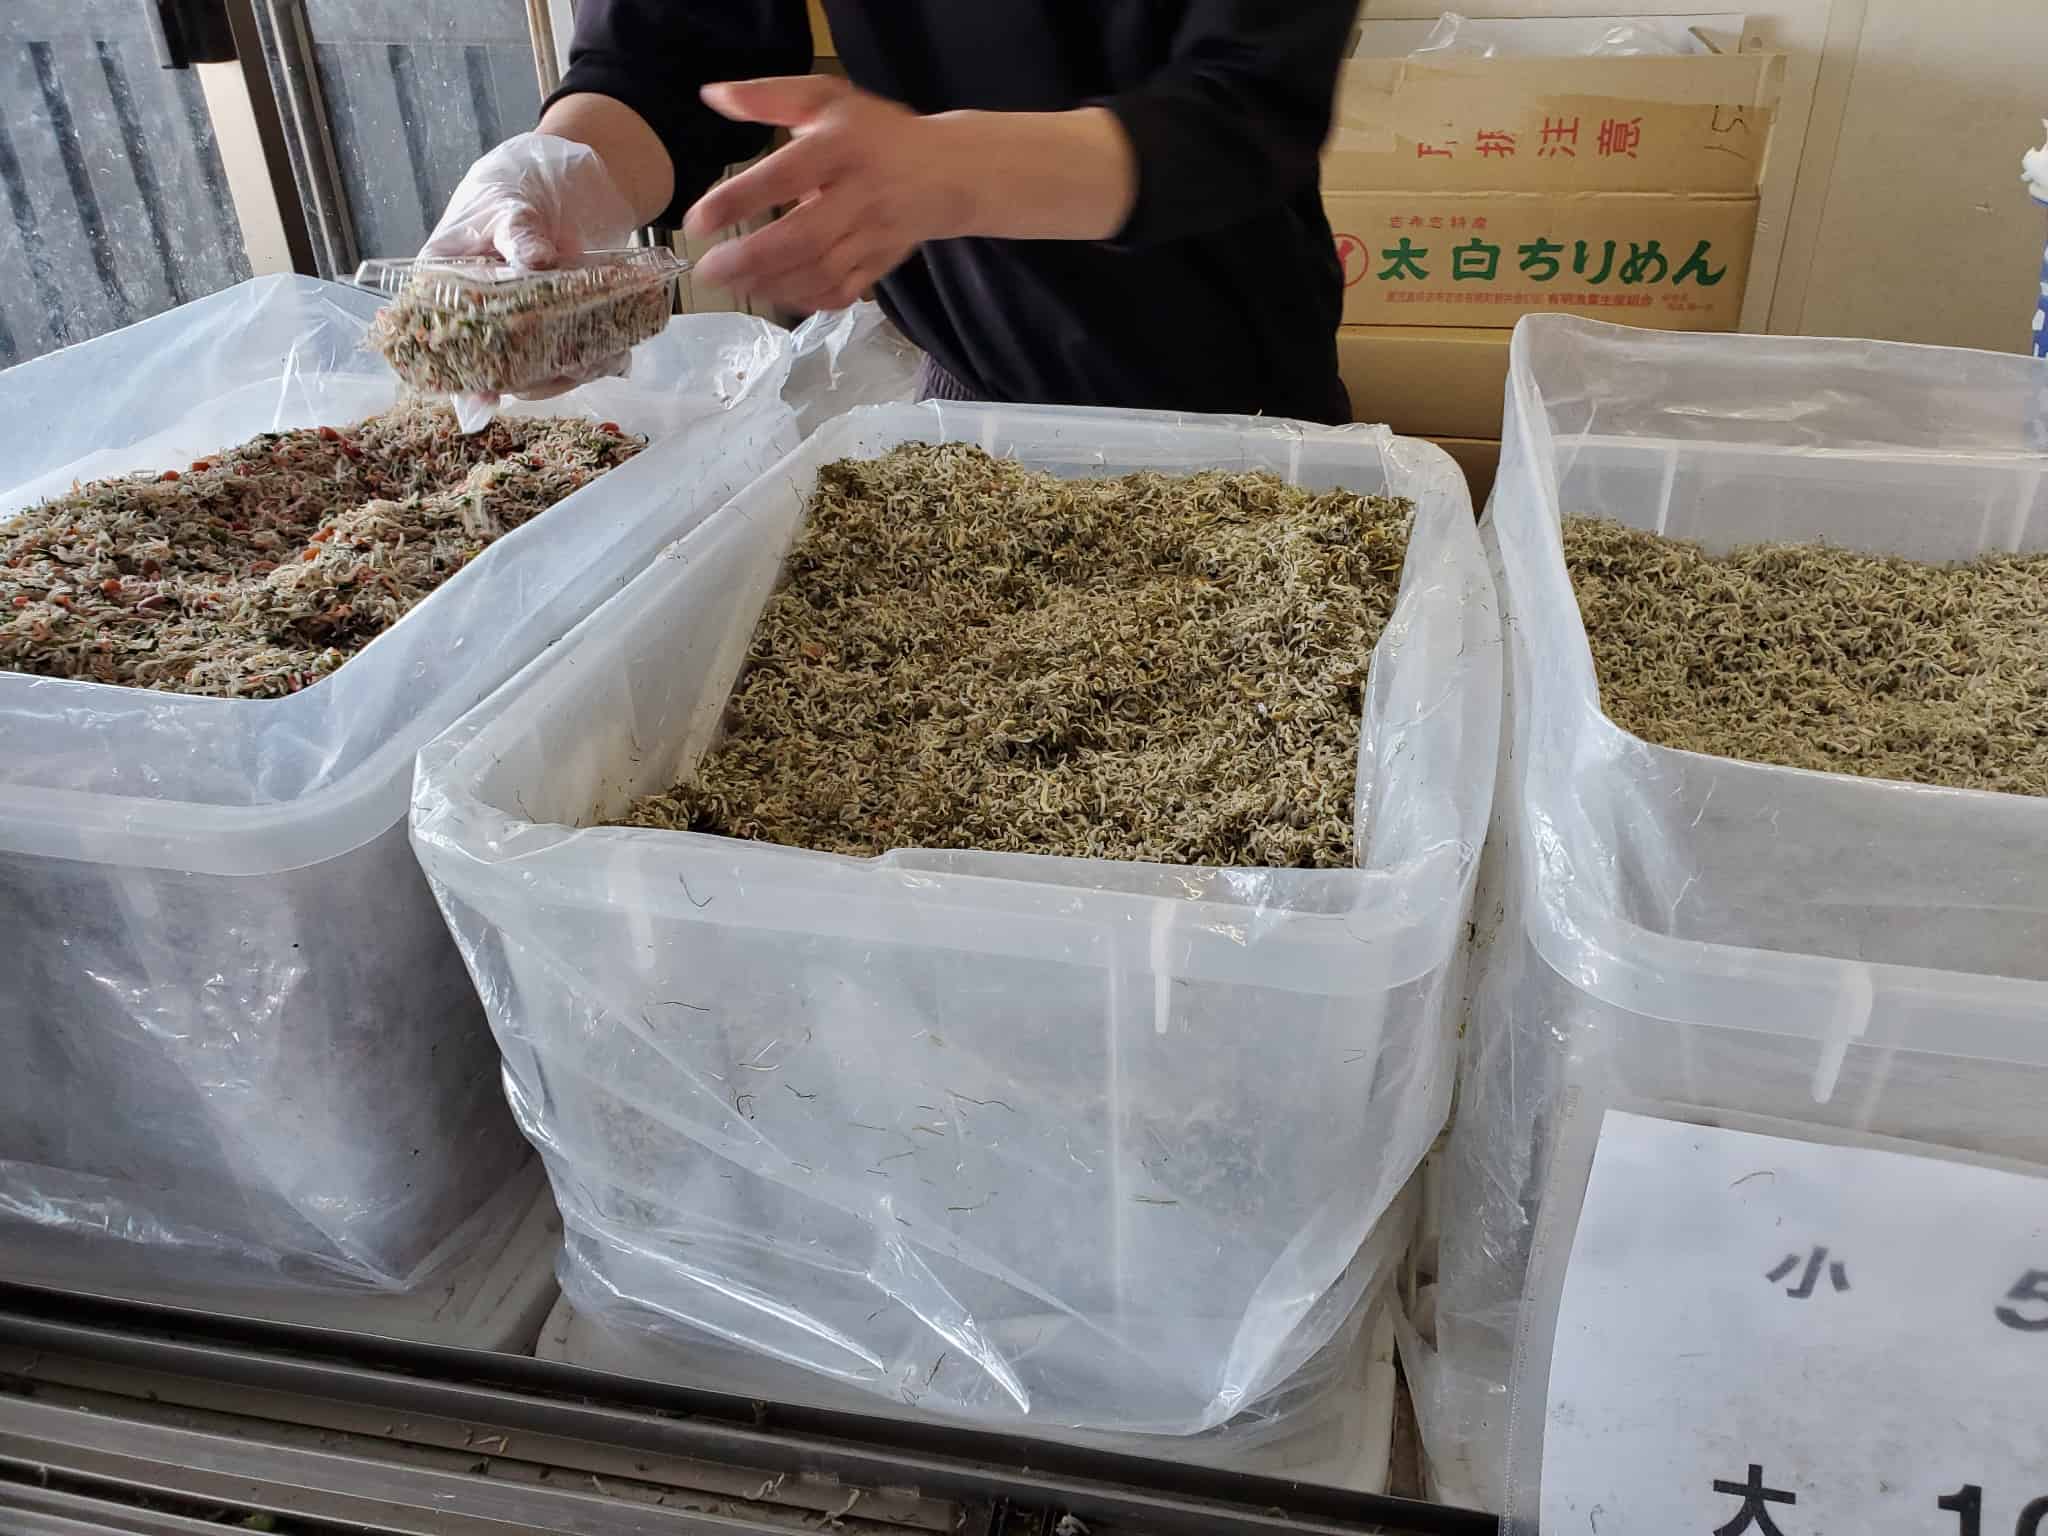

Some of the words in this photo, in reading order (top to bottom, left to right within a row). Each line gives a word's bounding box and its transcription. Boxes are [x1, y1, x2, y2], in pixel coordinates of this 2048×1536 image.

[1377, 237, 1728, 286] 太白ちりめん
[1764, 1245, 1852, 1300] 小
[1712, 1463, 1796, 1536] 大
